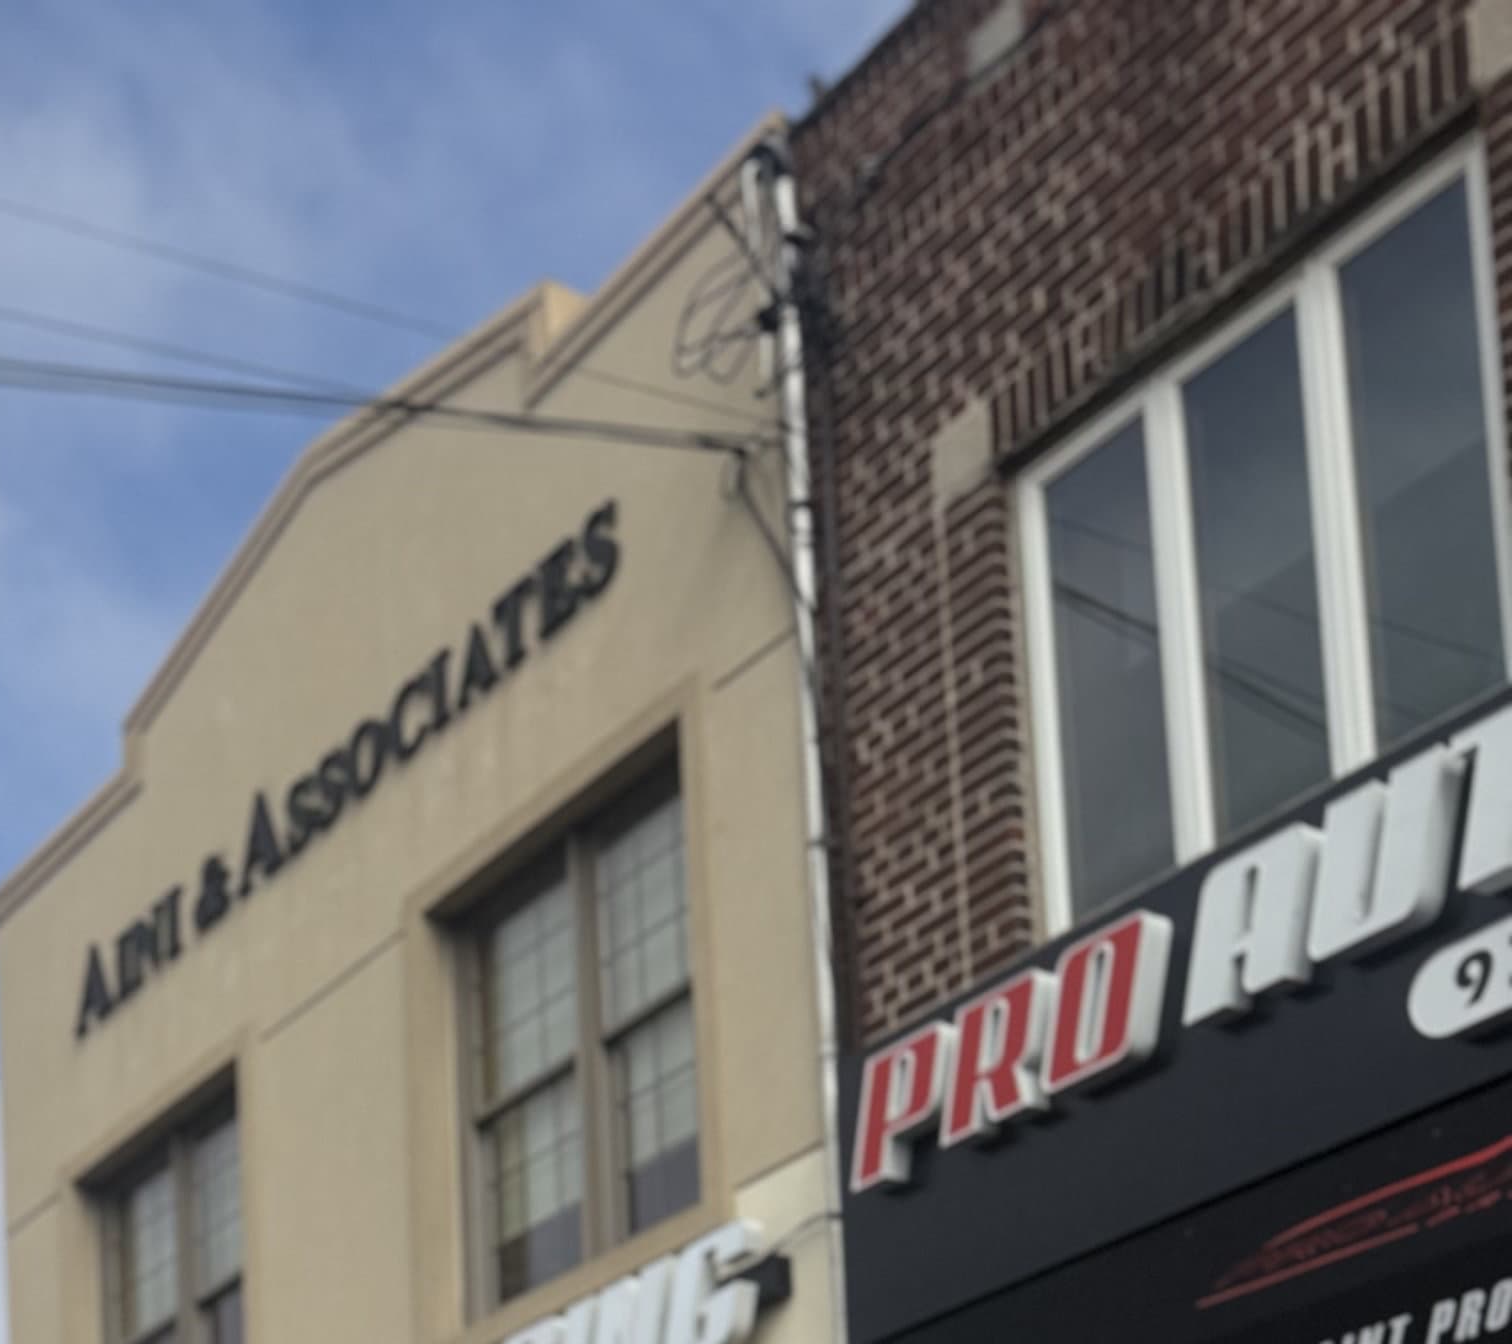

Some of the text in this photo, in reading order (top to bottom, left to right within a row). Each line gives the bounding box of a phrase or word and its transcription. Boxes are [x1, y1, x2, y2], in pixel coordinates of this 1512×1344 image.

[193, 854, 231, 934] &
[238, 499, 620, 898] ASSOCIATES
[850, 908, 1173, 1192] PRO
